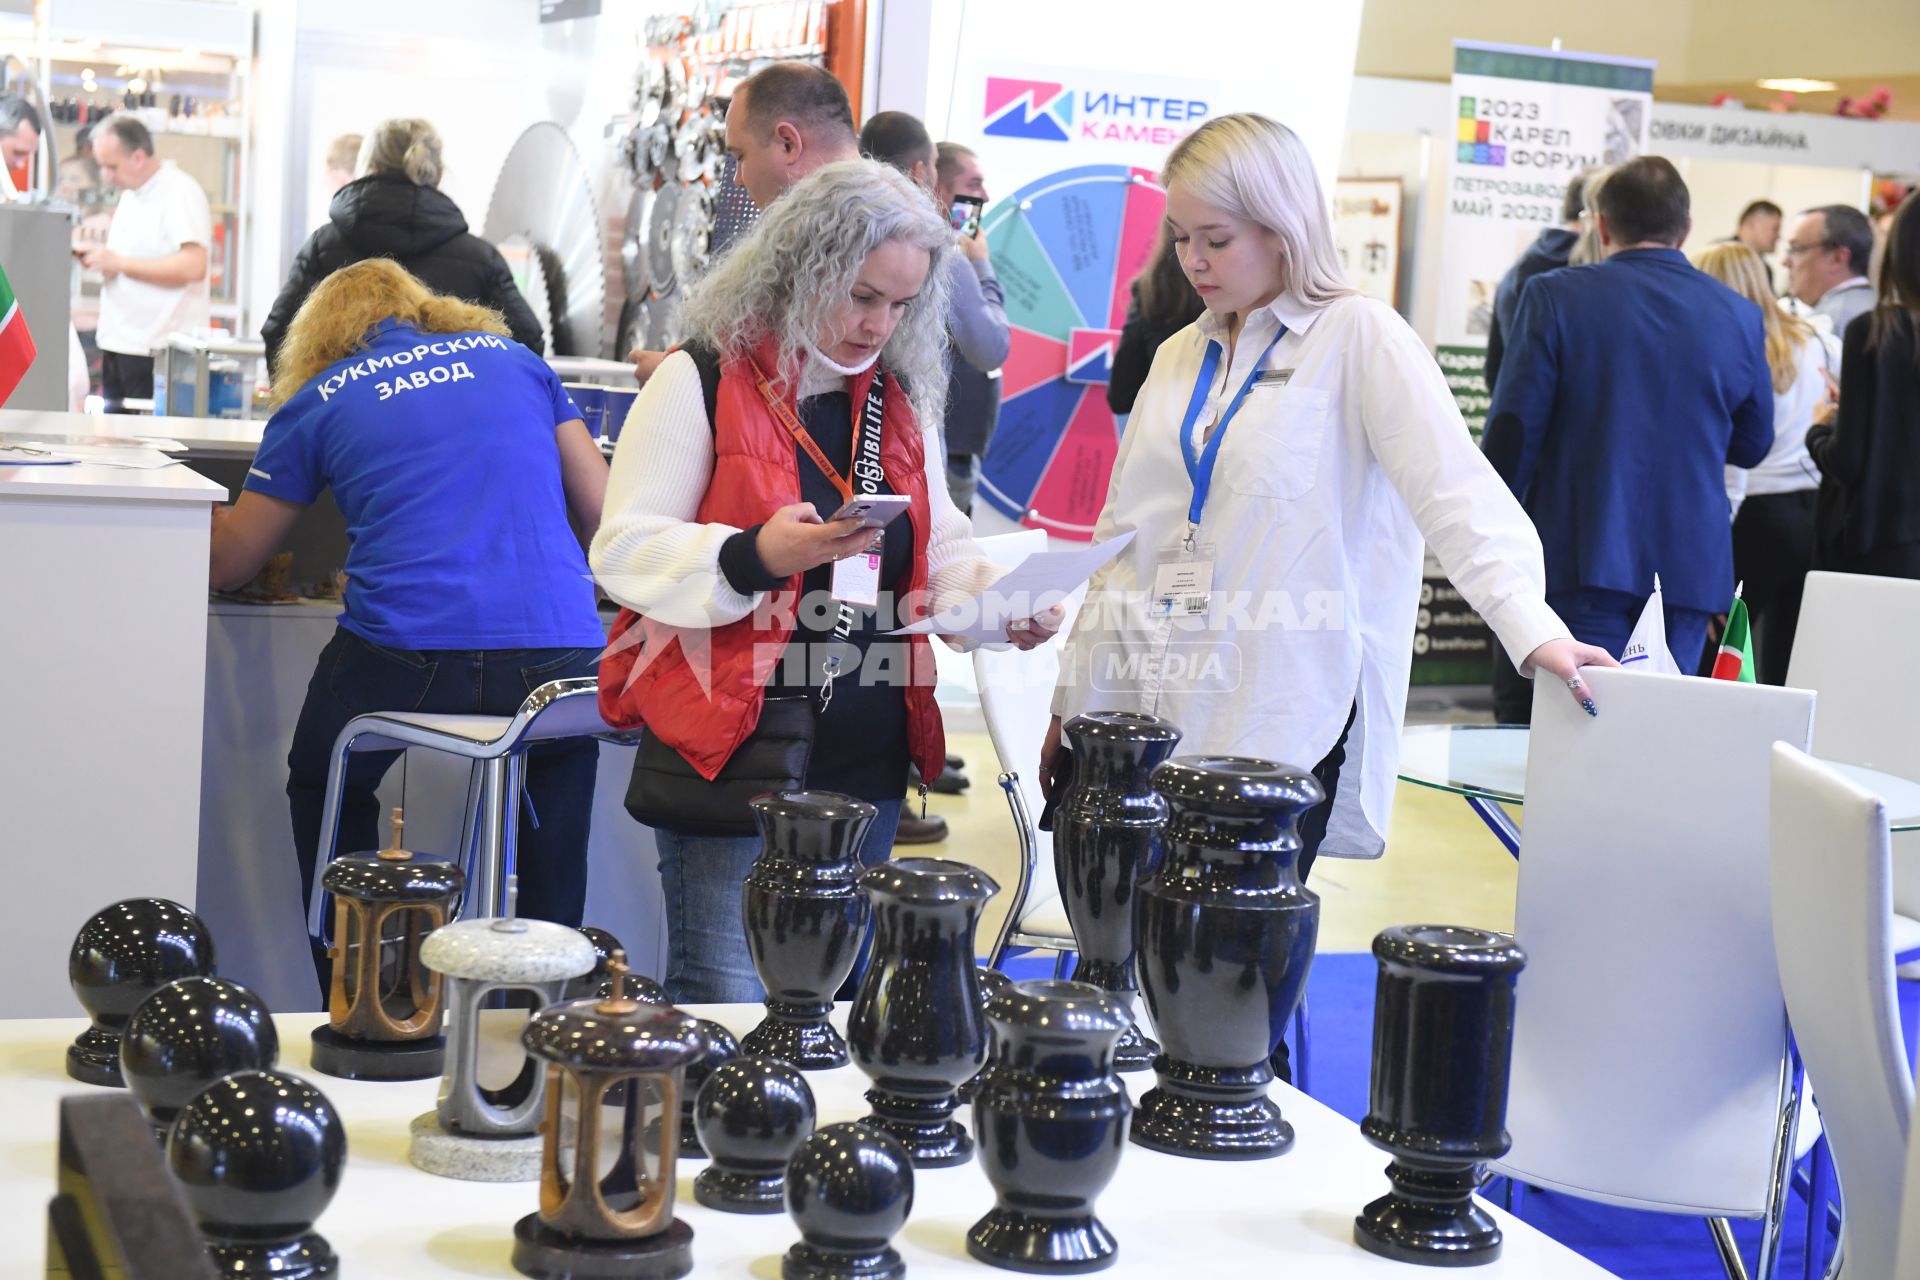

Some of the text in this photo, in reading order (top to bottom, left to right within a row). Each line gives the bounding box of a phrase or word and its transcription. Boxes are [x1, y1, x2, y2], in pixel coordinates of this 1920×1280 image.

[1084, 91, 1209, 121] ИНТЕР
[1481, 98, 1540, 120] 2023
[1494, 125, 1571, 147] КАРЕЛ
[1709, 123, 1810, 150] ДИЗАЙНА
[1453, 197, 1553, 223] МАЙ 2023
[317, 334, 508, 402] КУКМОРСКИЙ
[374, 361, 475, 401] ЗАВОД
[861, 393, 883, 495] OSSIBILITE
